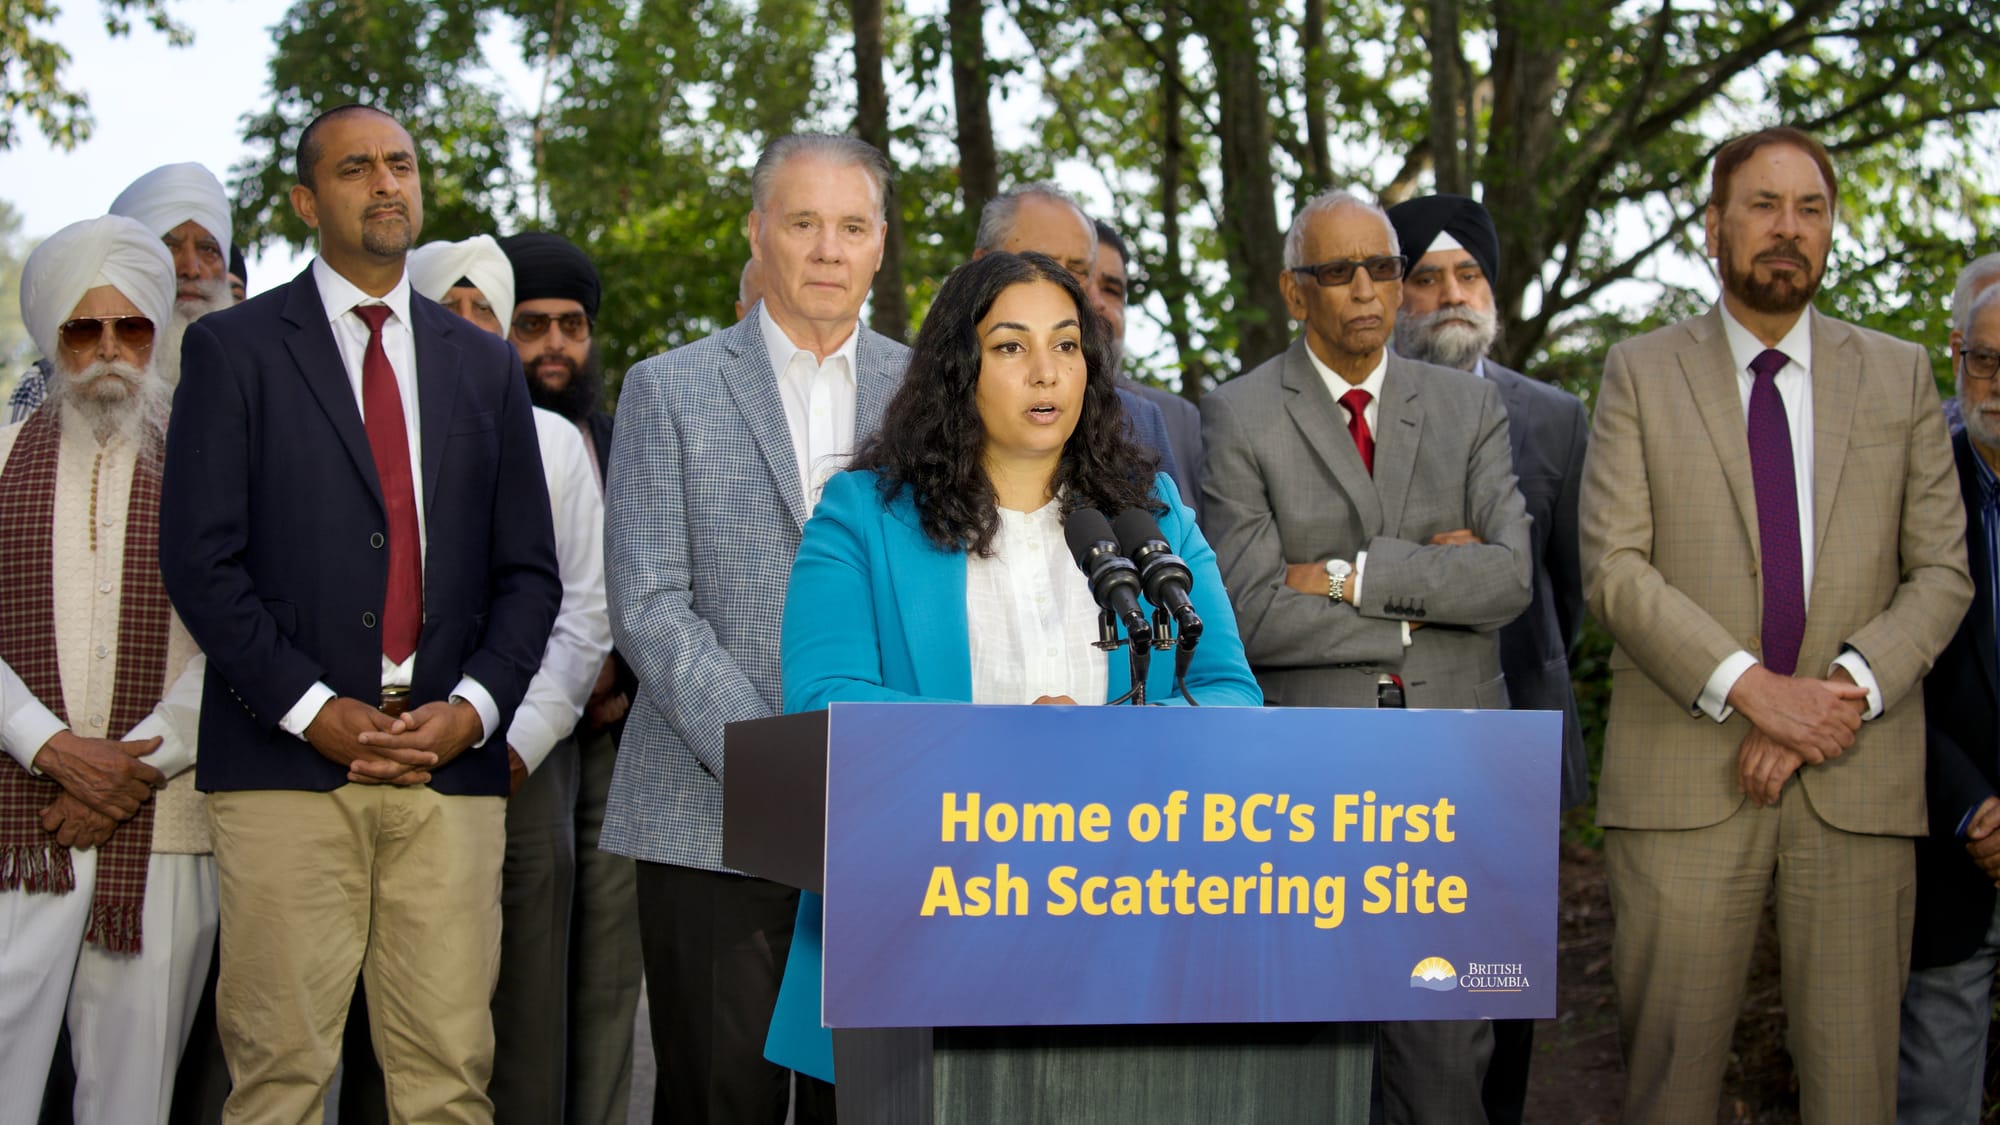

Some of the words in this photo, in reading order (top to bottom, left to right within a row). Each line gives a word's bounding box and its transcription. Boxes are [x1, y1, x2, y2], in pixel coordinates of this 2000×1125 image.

[941, 793, 1111, 842] Home
[1128, 790, 1188, 842] of
[1203, 793, 1315, 842] BC's
[1333, 791, 1456, 843] First
[920, 863, 1029, 917] Ash
[1047, 862, 1345, 929] Scattering
[1362, 862, 1468, 915] Site
[1460, 975, 1530, 988] COLUMBIA
[1469, 963, 1522, 975] BRITISH
